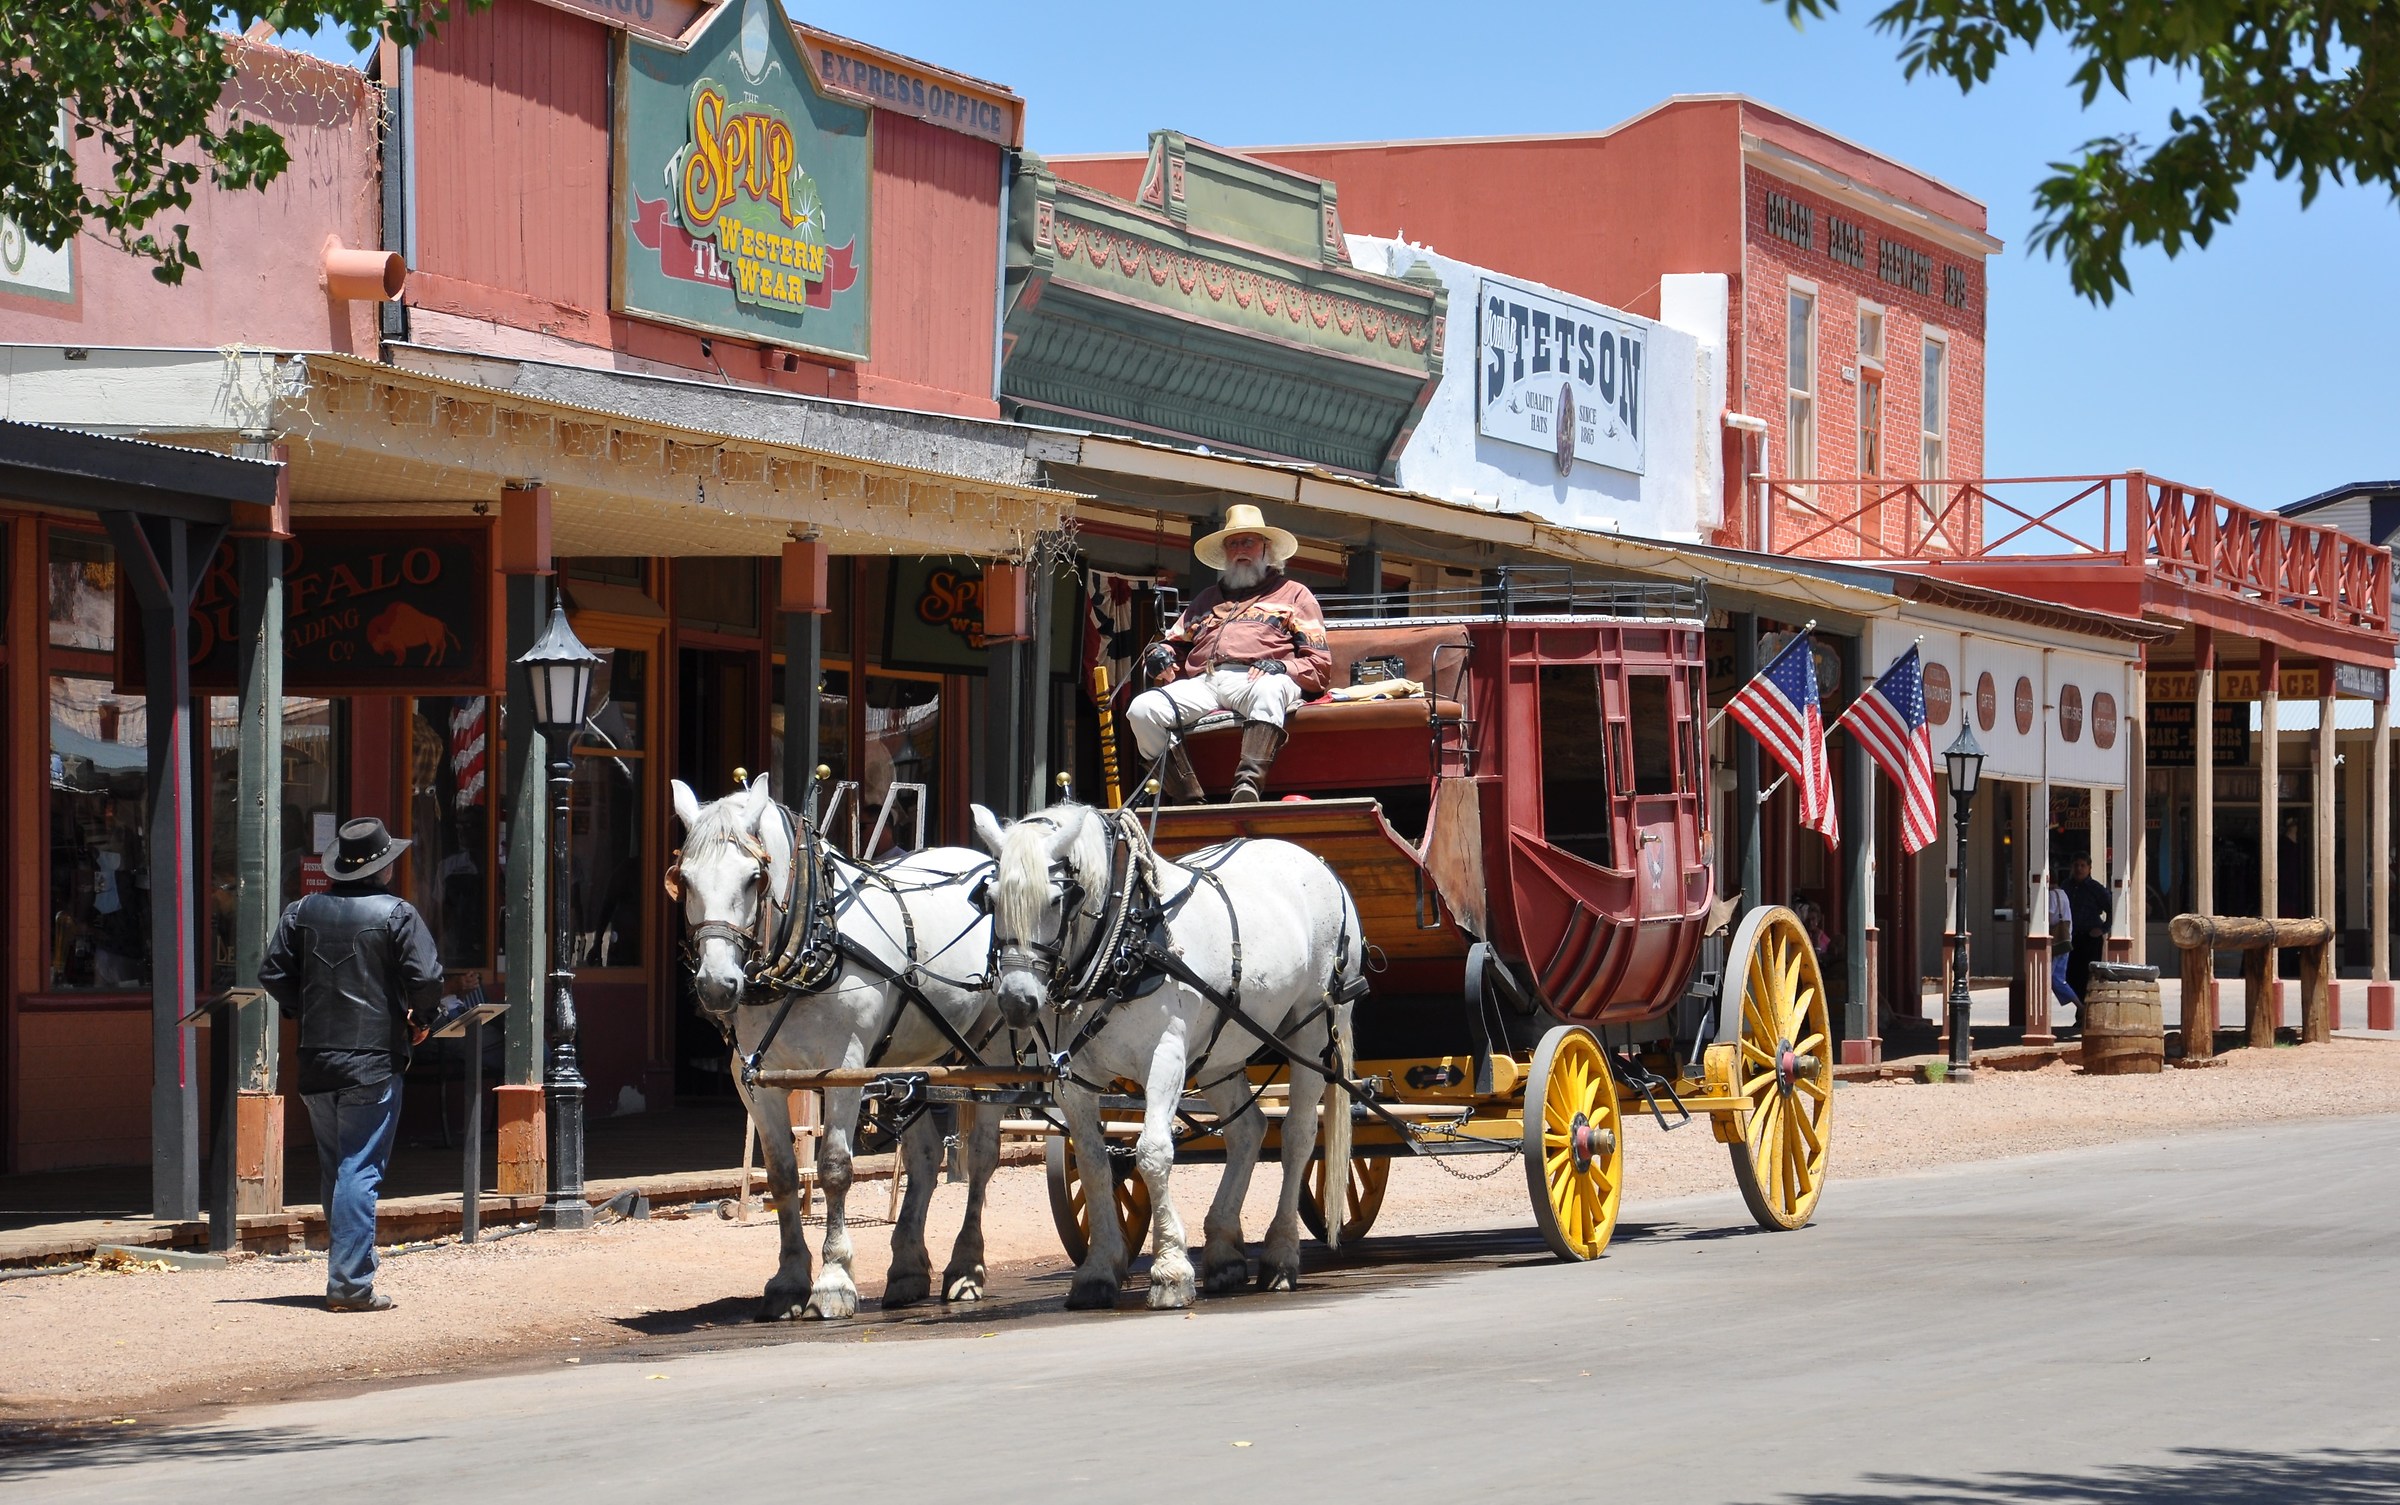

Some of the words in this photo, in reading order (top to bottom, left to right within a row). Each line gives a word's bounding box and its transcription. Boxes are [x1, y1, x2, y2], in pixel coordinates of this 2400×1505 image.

[821, 50, 924, 107] EXPRESS
[928, 85, 1001, 134] OFFICE
[1767, 191, 1813, 250] GOLDEN
[1829, 216, 1864, 270] EAGLE
[1879, 238, 1932, 296] BREWERY
[1944, 263, 1967, 309] 1879
[1484, 309, 1508, 348] JOHN
[1488, 296, 1641, 438] STETSON
[1525, 391, 1553, 414] QUALITY
[1579, 405, 1597, 425] SINCE
[1531, 414, 1548, 434] HATS
[1580, 426, 1595, 445] 1865
